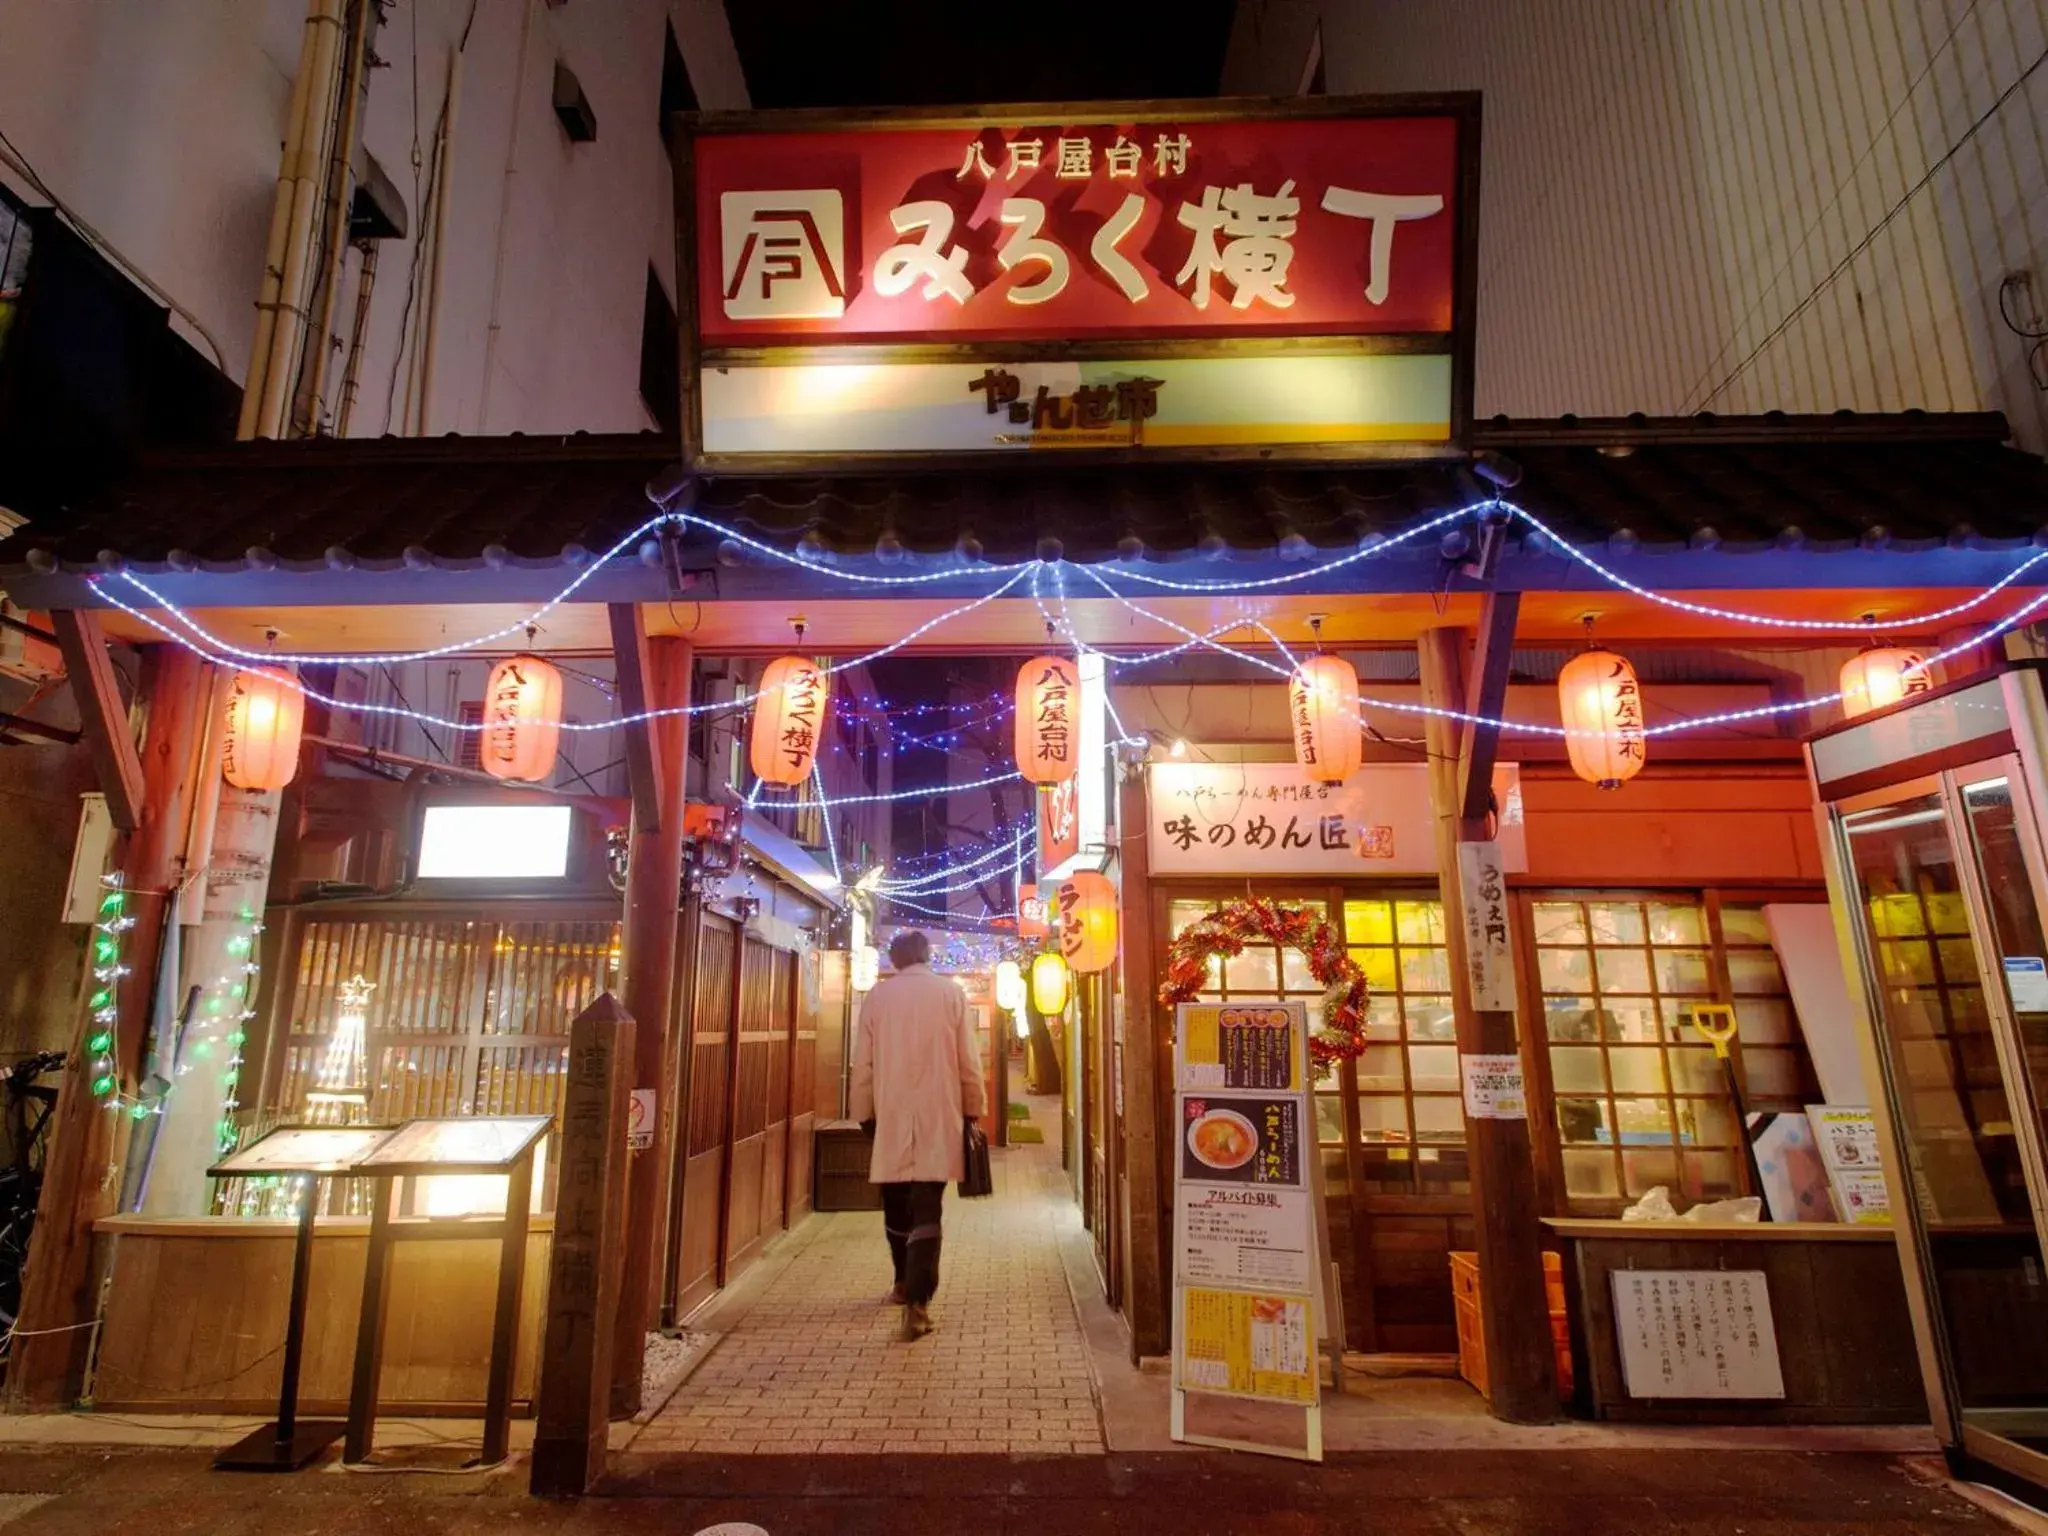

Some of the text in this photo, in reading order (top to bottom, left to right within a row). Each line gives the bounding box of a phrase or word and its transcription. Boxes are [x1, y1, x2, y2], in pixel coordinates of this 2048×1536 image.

[956, 134, 1192, 180] 八戸屋台村
[873, 180, 1444, 312] みろく横丁
[781, 667, 821, 766] みろく横丁
[1036, 664, 1070, 762] 八戸屋台村
[1163, 814, 1351, 851] 味のめん匠
[1058, 883, 1085, 957] ラーメン
[1208, 1190, 1278, 1206] アルバイト募集
